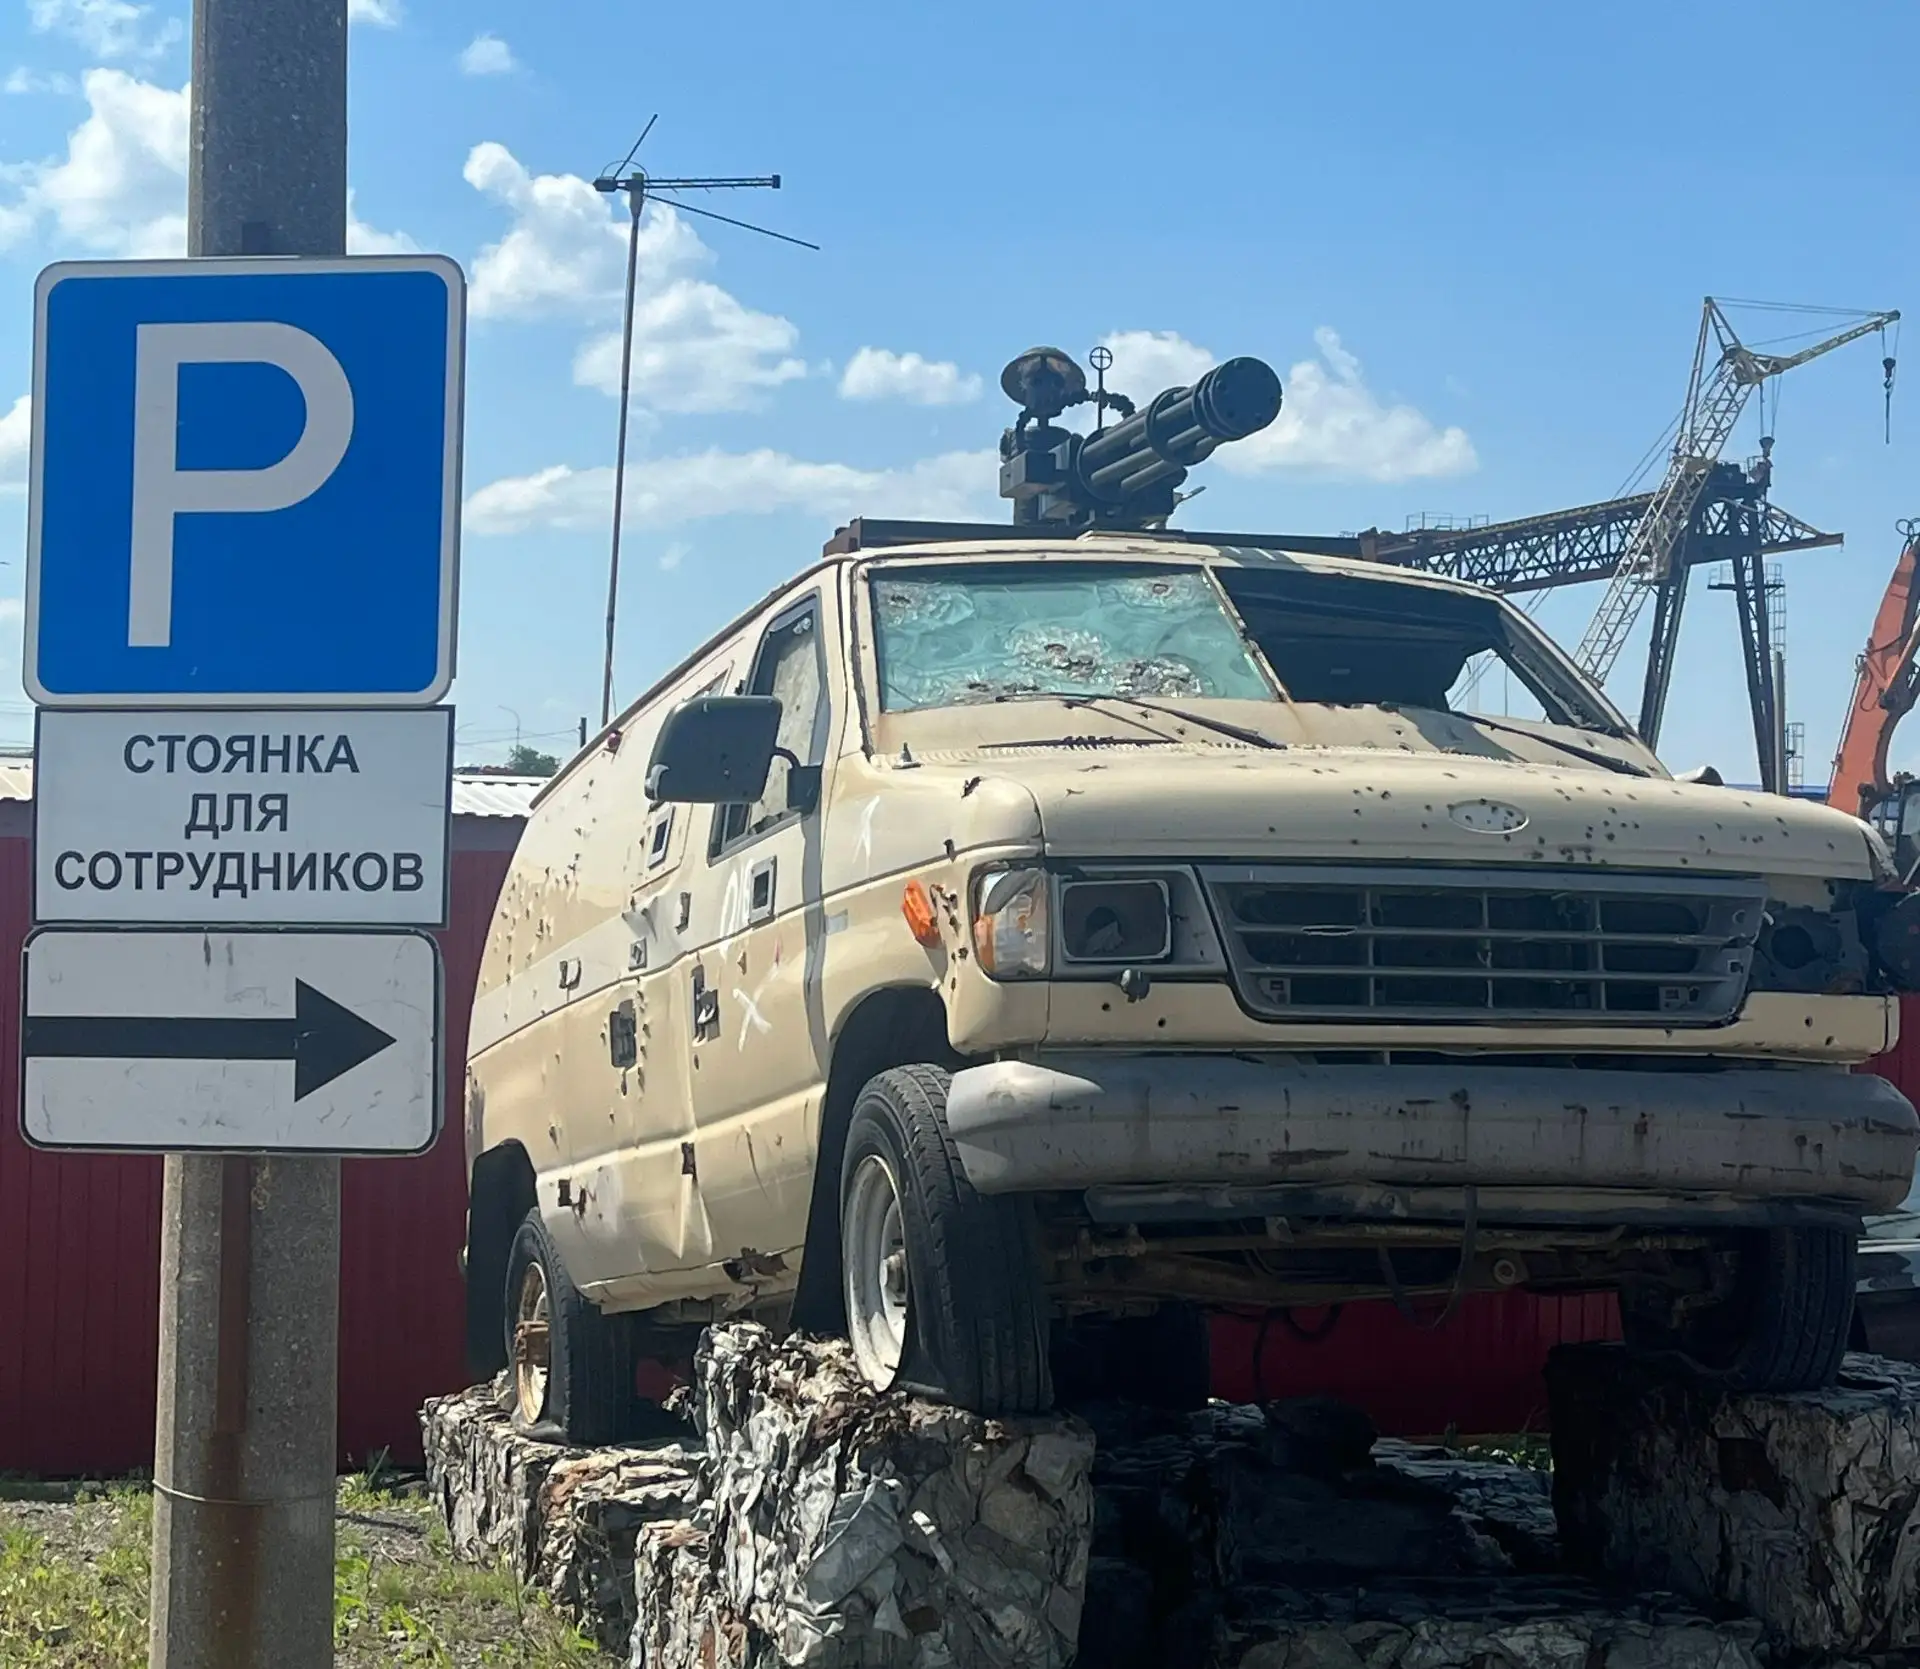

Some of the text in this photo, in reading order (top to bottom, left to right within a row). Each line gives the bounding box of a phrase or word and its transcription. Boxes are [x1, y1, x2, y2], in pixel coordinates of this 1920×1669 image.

[128, 321, 354, 647] P
[123, 734, 361, 774] СТОЯНКА
[184, 792, 289, 840] ДЛЯ
[54, 850, 424, 899] СОТРУДНИКОВ
